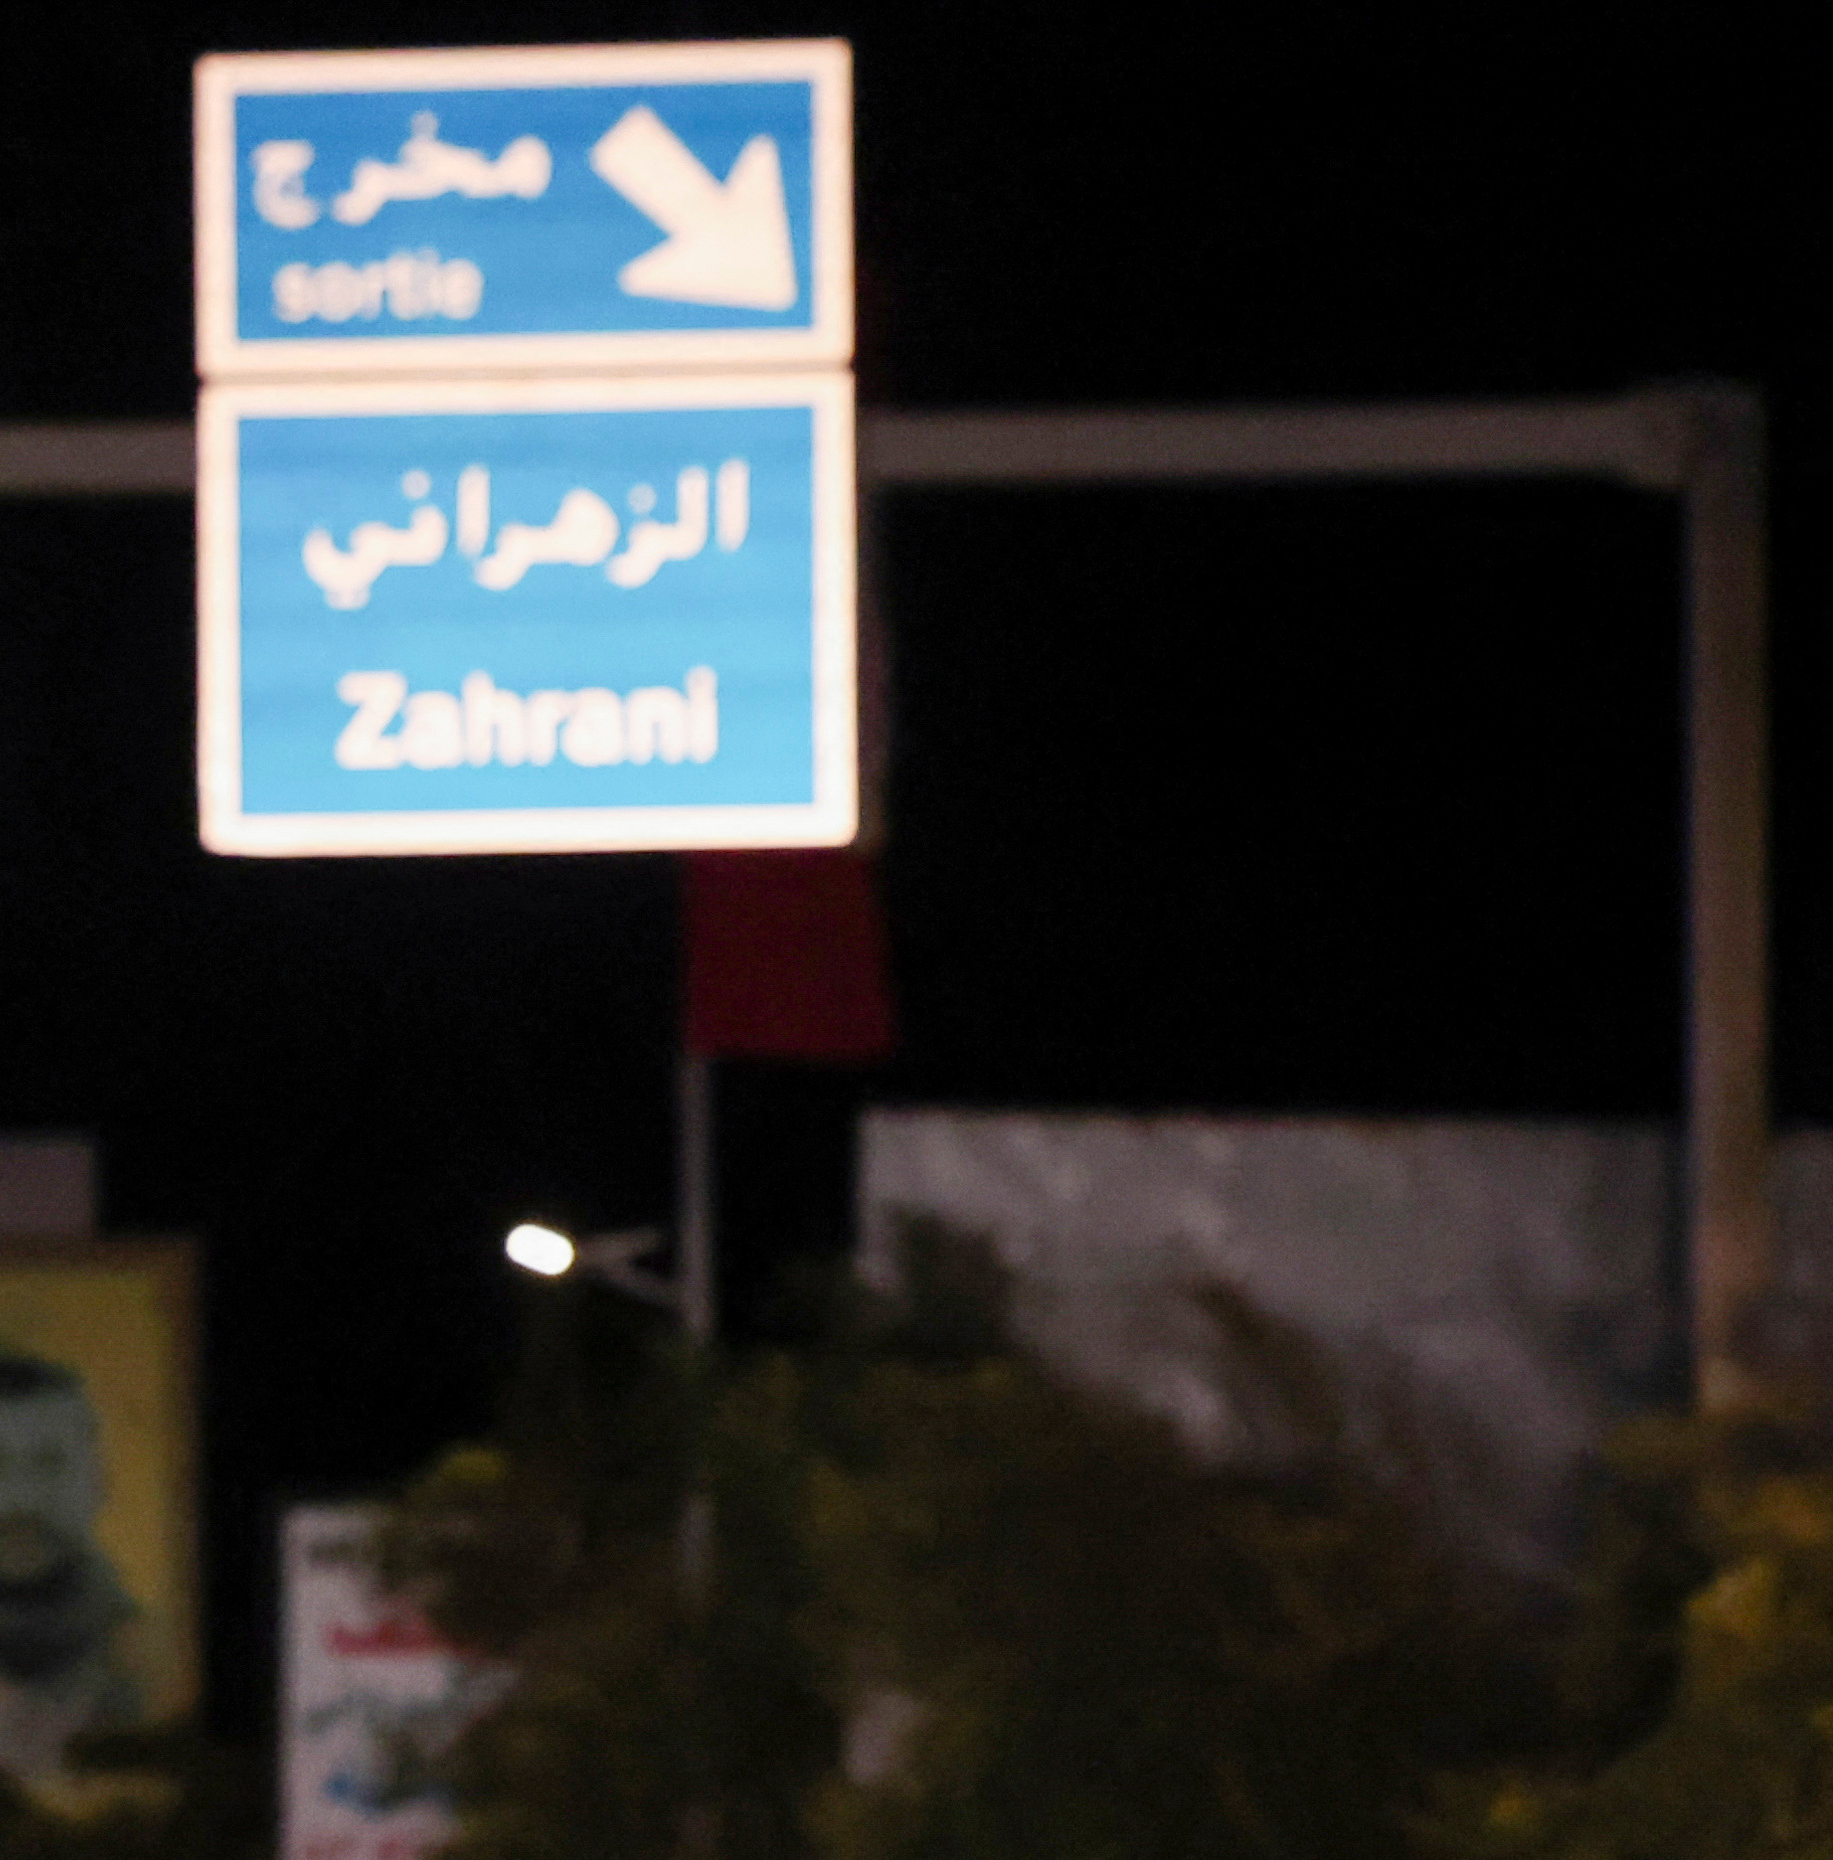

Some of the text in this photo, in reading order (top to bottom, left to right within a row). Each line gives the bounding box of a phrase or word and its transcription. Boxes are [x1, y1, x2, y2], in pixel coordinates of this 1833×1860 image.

[250, 112, 553, 230] مخرج
[302, 458, 750, 610] الزهراني
[335, 664, 719, 771] Zahrani
